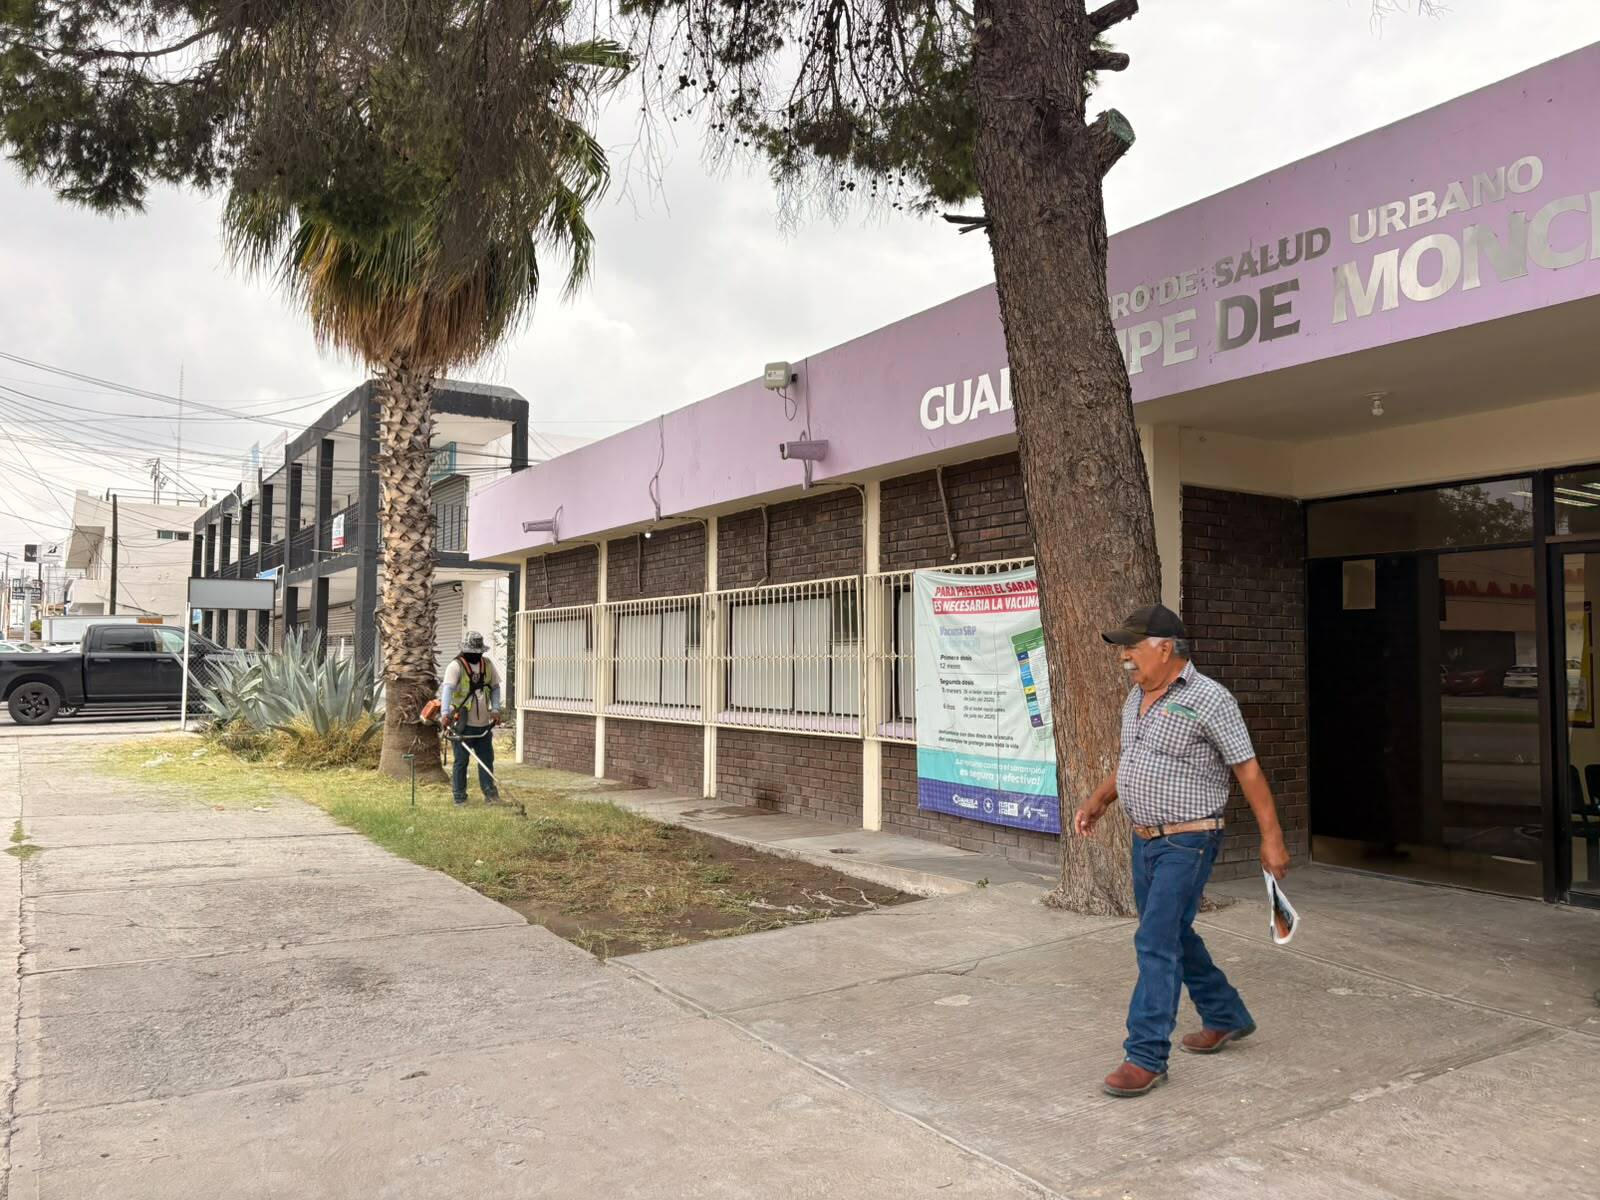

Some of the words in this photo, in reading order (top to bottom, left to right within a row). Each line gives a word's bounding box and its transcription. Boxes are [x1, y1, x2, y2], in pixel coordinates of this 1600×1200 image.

[1158, 271, 1199, 305] DE
[1214, 227, 1331, 288] SALUD
[1350, 155, 1543, 244] URBANO
[1215, 278, 1300, 353] DE
[934, 601, 943, 612] ES
[943, 599, 990, 612] NECESARIA
[992, 598, 1003, 610] LA
[957, 584, 994, 596] PREVENIR
[995, 583, 1004, 594] EL
